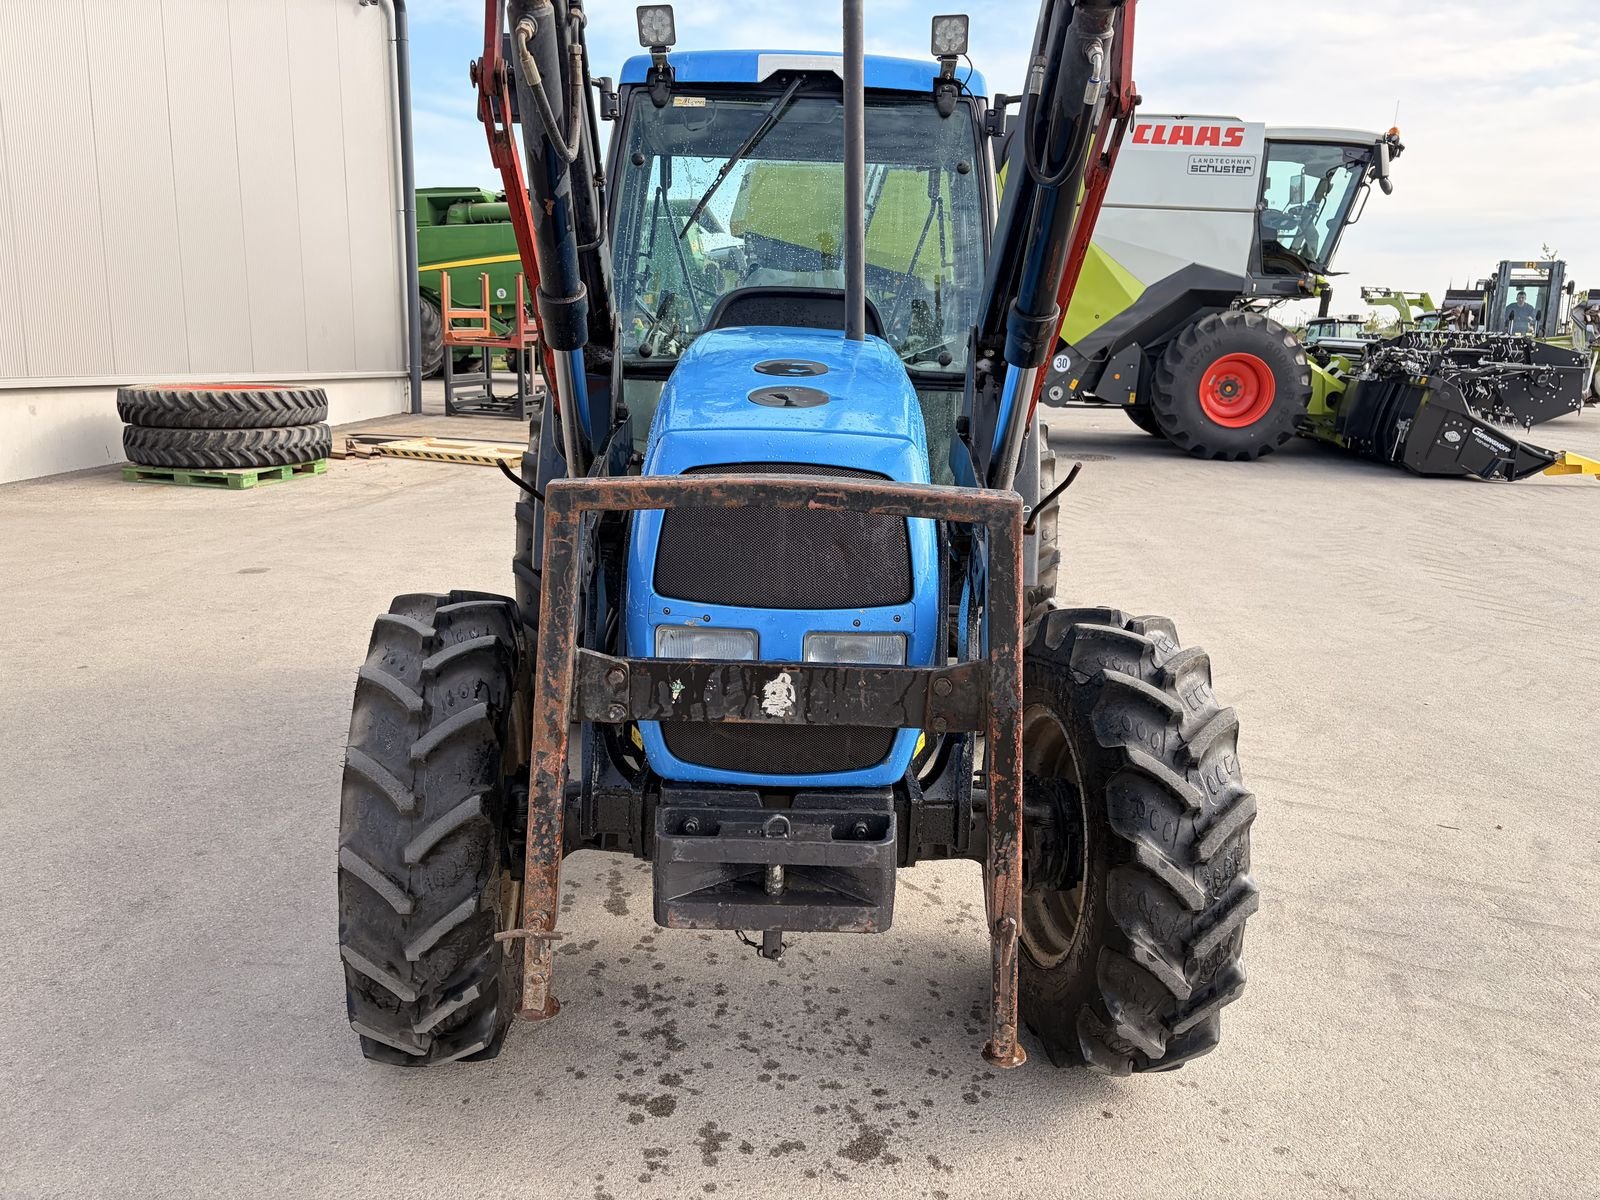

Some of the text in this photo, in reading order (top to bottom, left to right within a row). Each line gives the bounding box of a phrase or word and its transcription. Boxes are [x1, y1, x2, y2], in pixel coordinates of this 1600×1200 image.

[1132, 125, 1245, 147] CLAAS
[1190, 164, 1252, 174] schuster
[1056, 358, 1068, 368] 30
